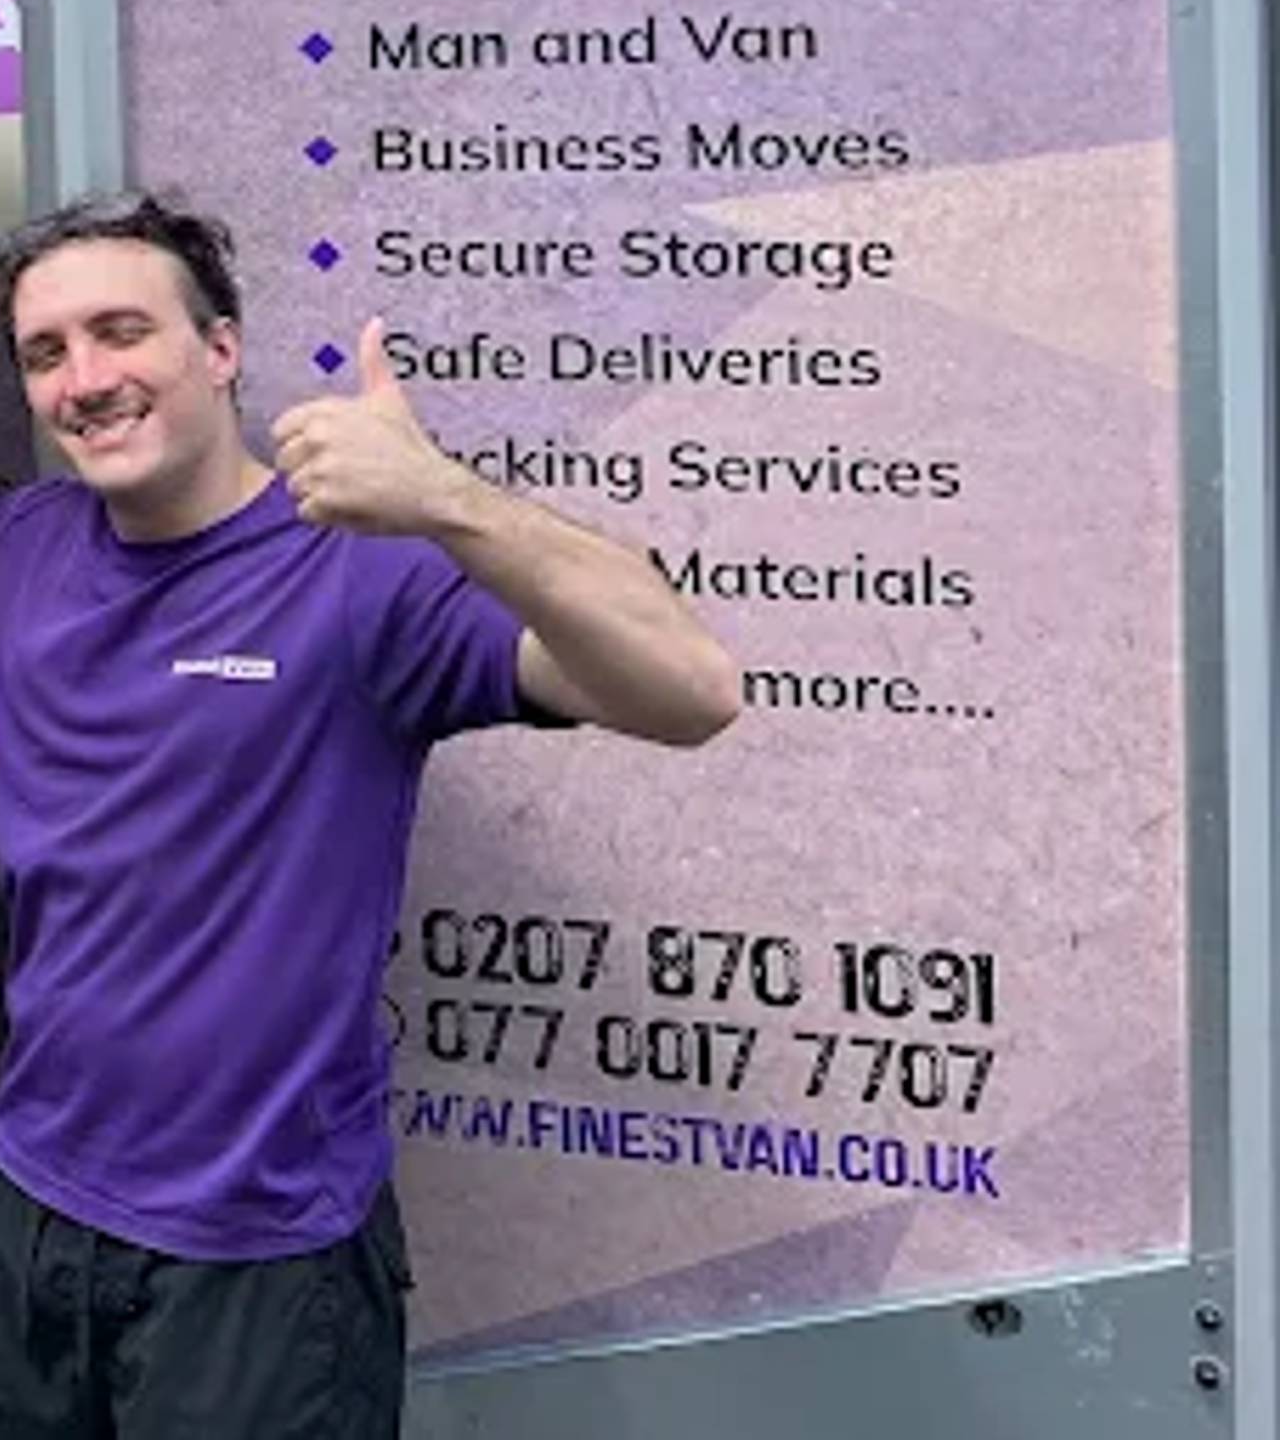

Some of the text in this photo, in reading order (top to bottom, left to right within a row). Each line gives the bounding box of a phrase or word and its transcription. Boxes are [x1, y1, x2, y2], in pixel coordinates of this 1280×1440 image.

[368, 15, 818, 70] Man and Van
[372, 123, 912, 173] Business Moves
[374, 230, 896, 290] Secure Storage
[382, 332, 882, 387] Safe Deliveries
[443, 436, 962, 503] cking Services
[648, 547, 976, 608] Materials
[421, 910, 996, 1024] 0207 870 1091
[426, 1000, 564, 1069] 077
[793, 1032, 996, 1113] 7707
[388, 1087, 1000, 1200] WW.FINESTVAN.CO.UK
